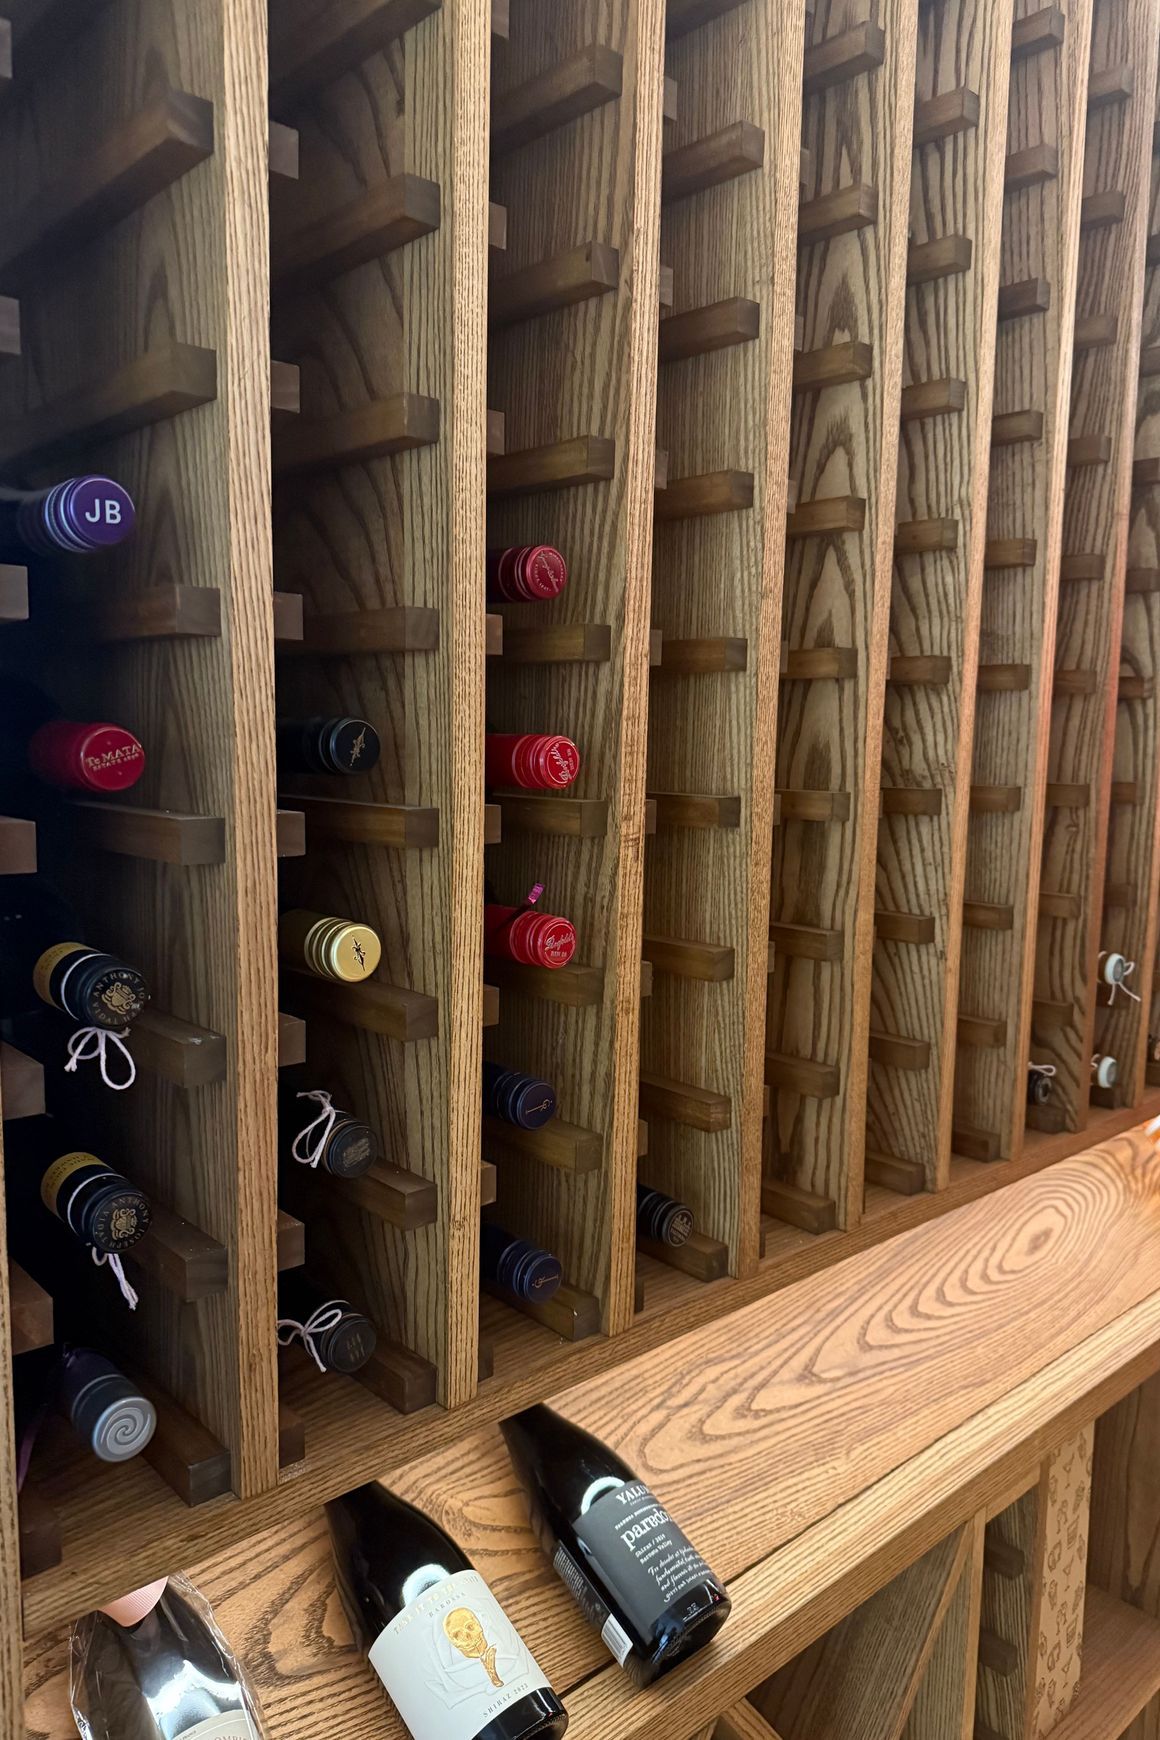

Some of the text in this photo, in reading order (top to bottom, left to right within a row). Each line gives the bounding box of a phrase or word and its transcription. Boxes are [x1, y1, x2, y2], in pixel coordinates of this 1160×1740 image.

[84, 498, 122, 525] JB
[101, 744, 141, 763] MATA
[482, 1692, 512, 1719] SHIRAZ
